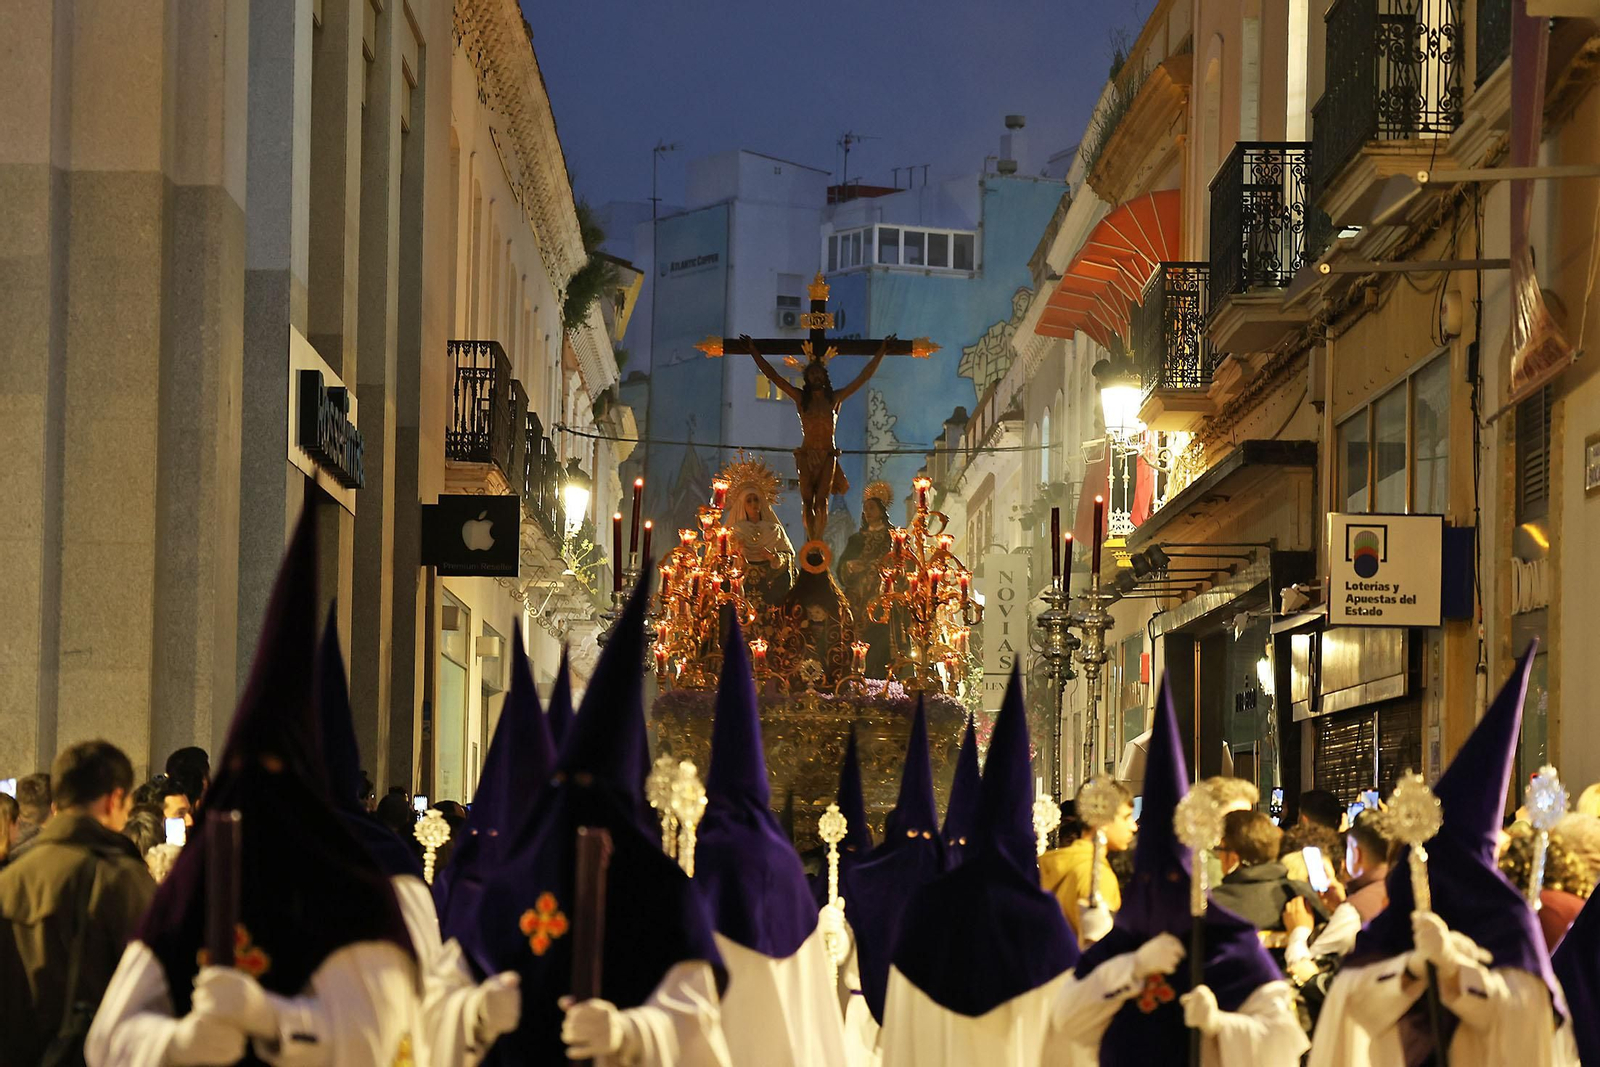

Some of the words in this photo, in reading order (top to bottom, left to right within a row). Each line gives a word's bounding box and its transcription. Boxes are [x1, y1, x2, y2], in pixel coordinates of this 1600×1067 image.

[443, 562, 478, 570] Premium
[480, 562, 512, 571] Reseller
[1393, 584, 1400, 594] y
[1345, 594, 1397, 605] Apuestas
[1399, 594, 1417, 605] del
[1345, 606, 1383, 616] Estado
[997, 570, 1015, 670] NOVIAS
